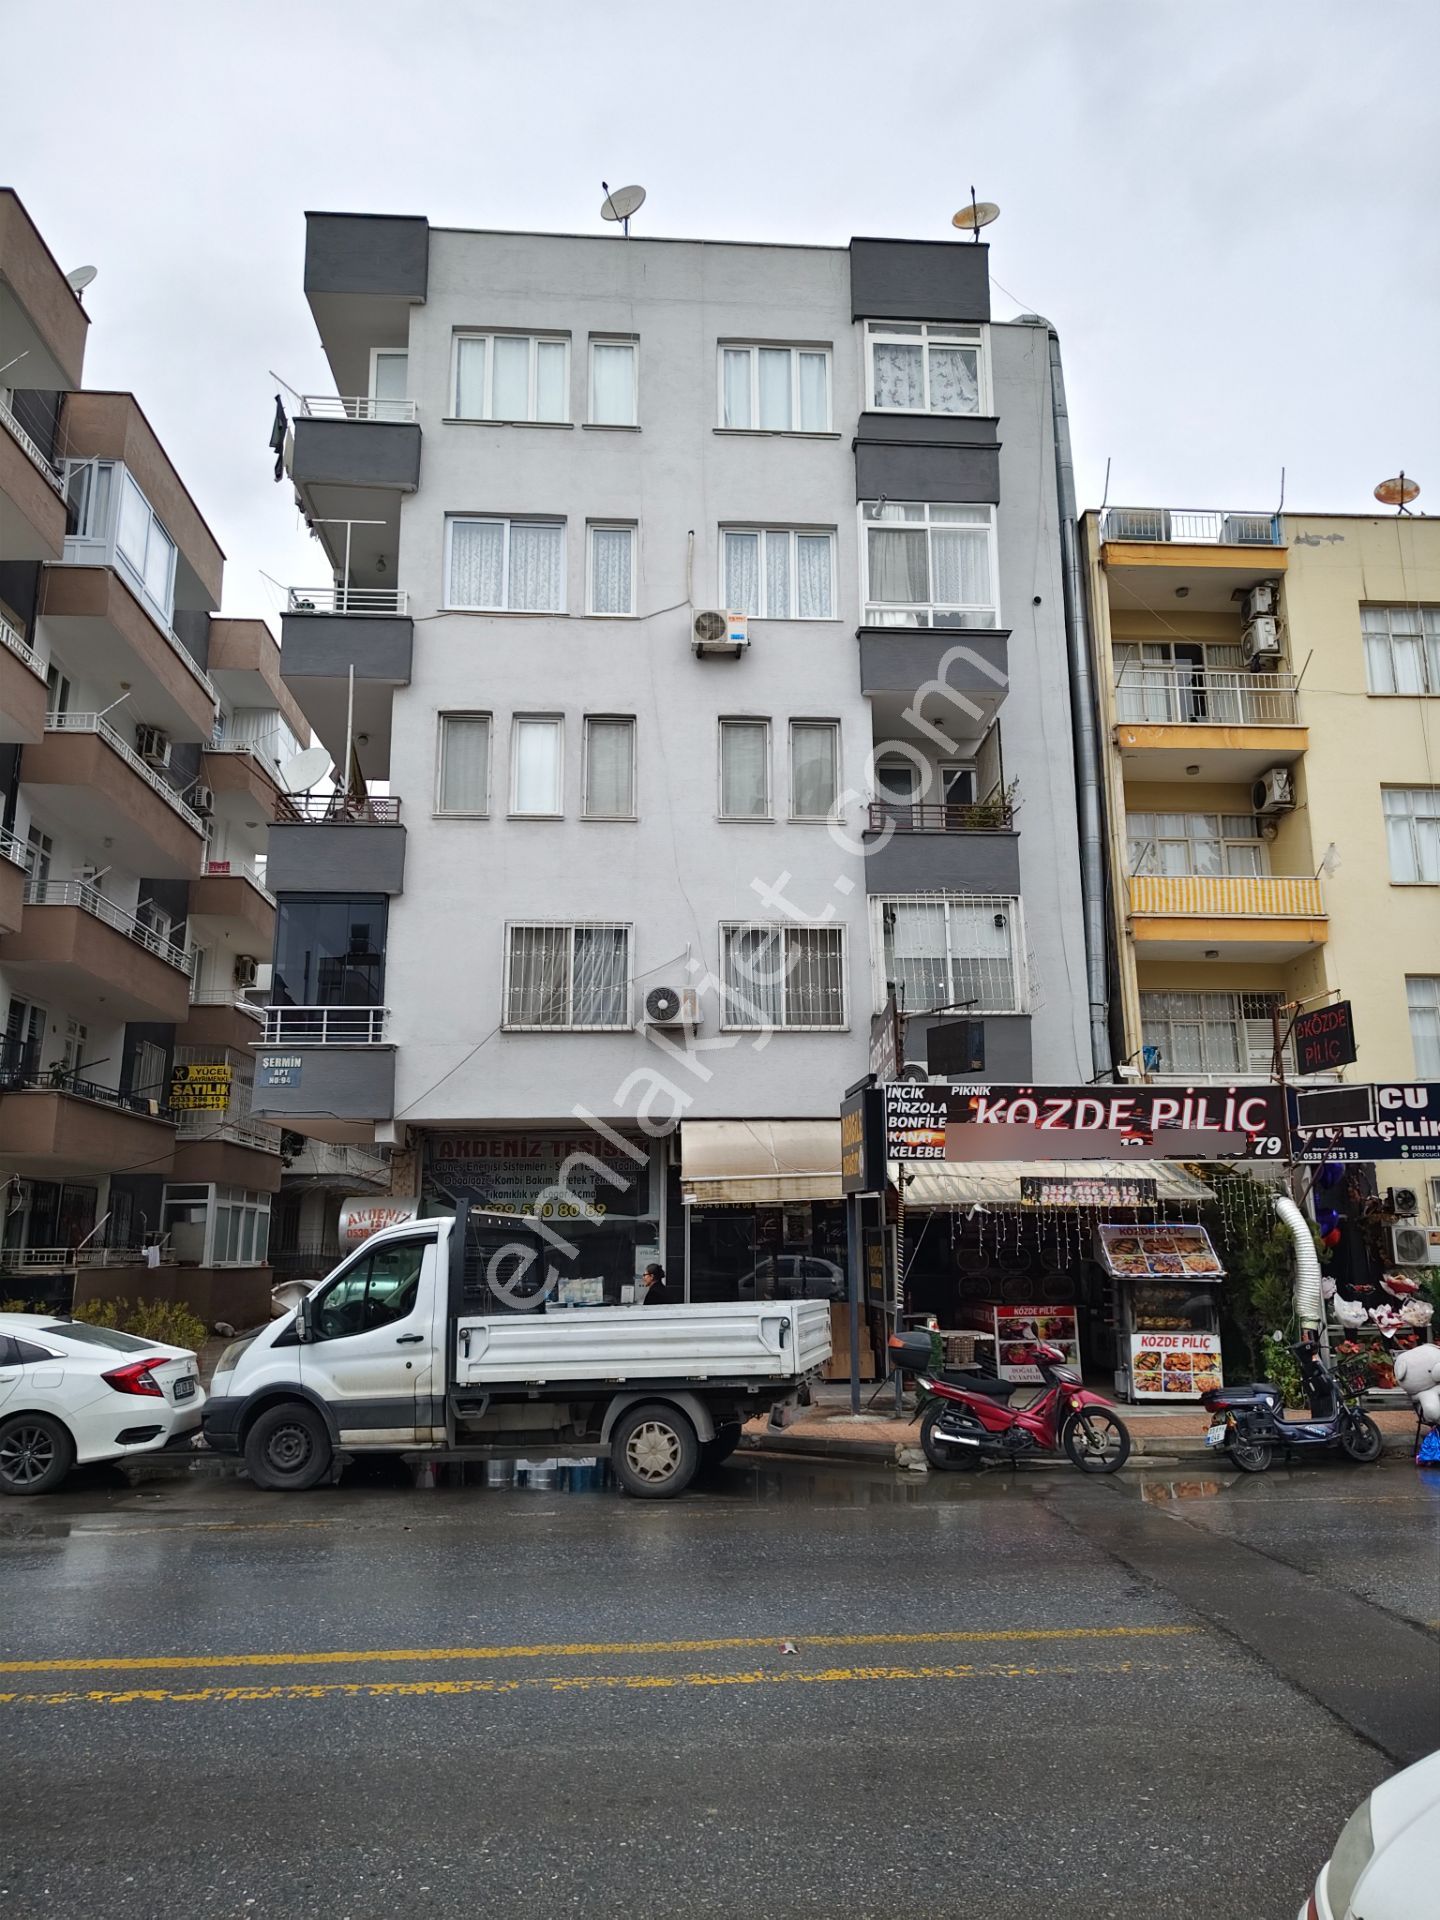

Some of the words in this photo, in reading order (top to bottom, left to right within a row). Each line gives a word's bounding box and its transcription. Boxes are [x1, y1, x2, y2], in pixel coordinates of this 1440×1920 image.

[262, 1056, 302, 1069] ŞERMİN
[195, 1067, 228, 1076] YÜCEL
[172, 1084, 229, 1096] SATILIK
[975, 1088, 1137, 1131] KÖZDE
[888, 1114, 947, 1129] BONFİLE
[889, 1130, 933, 1143] KANAT
[440, 1137, 542, 1158] AKDENİZ
[890, 1146, 945, 1158] KELEBE
[1303, 1152, 1322, 1160] 0538
[1349, 1151, 1359, 1159] 33
[503, 1161, 546, 1171] Sistemleri
[495, 1175, 523, 1185] Kombi
[525, 1175, 553, 1185] Bakım
[529, 1191, 539, 1199] ve
[558, 1203, 580, 1217] 80
